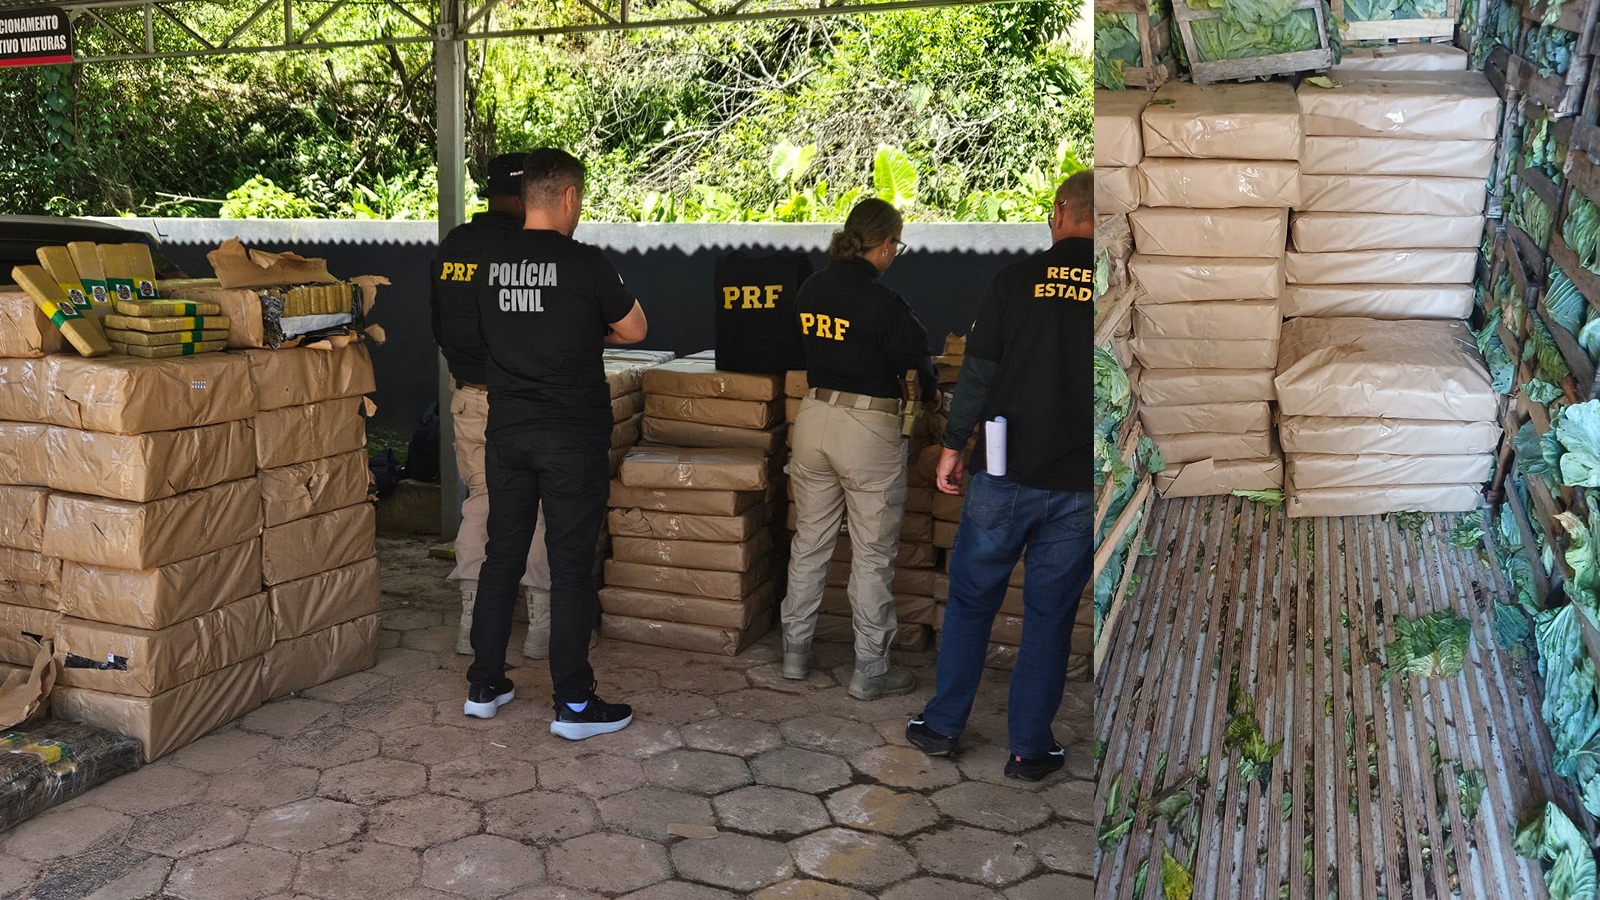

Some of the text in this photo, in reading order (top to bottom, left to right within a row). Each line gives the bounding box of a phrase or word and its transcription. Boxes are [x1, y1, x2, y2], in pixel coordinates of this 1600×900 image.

[0, 15, 58, 34] CIONAMENTO
[20, 35, 67, 53] VIATURAS
[440, 262, 478, 281] PRF
[488, 259, 558, 286] POLÍCIA
[1047, 266, 1094, 283] RECE
[499, 288, 544, 312] CIVIL
[722, 285, 783, 309] PRF
[1034, 283, 1094, 302] ESTAD
[800, 312, 850, 341] PRF
